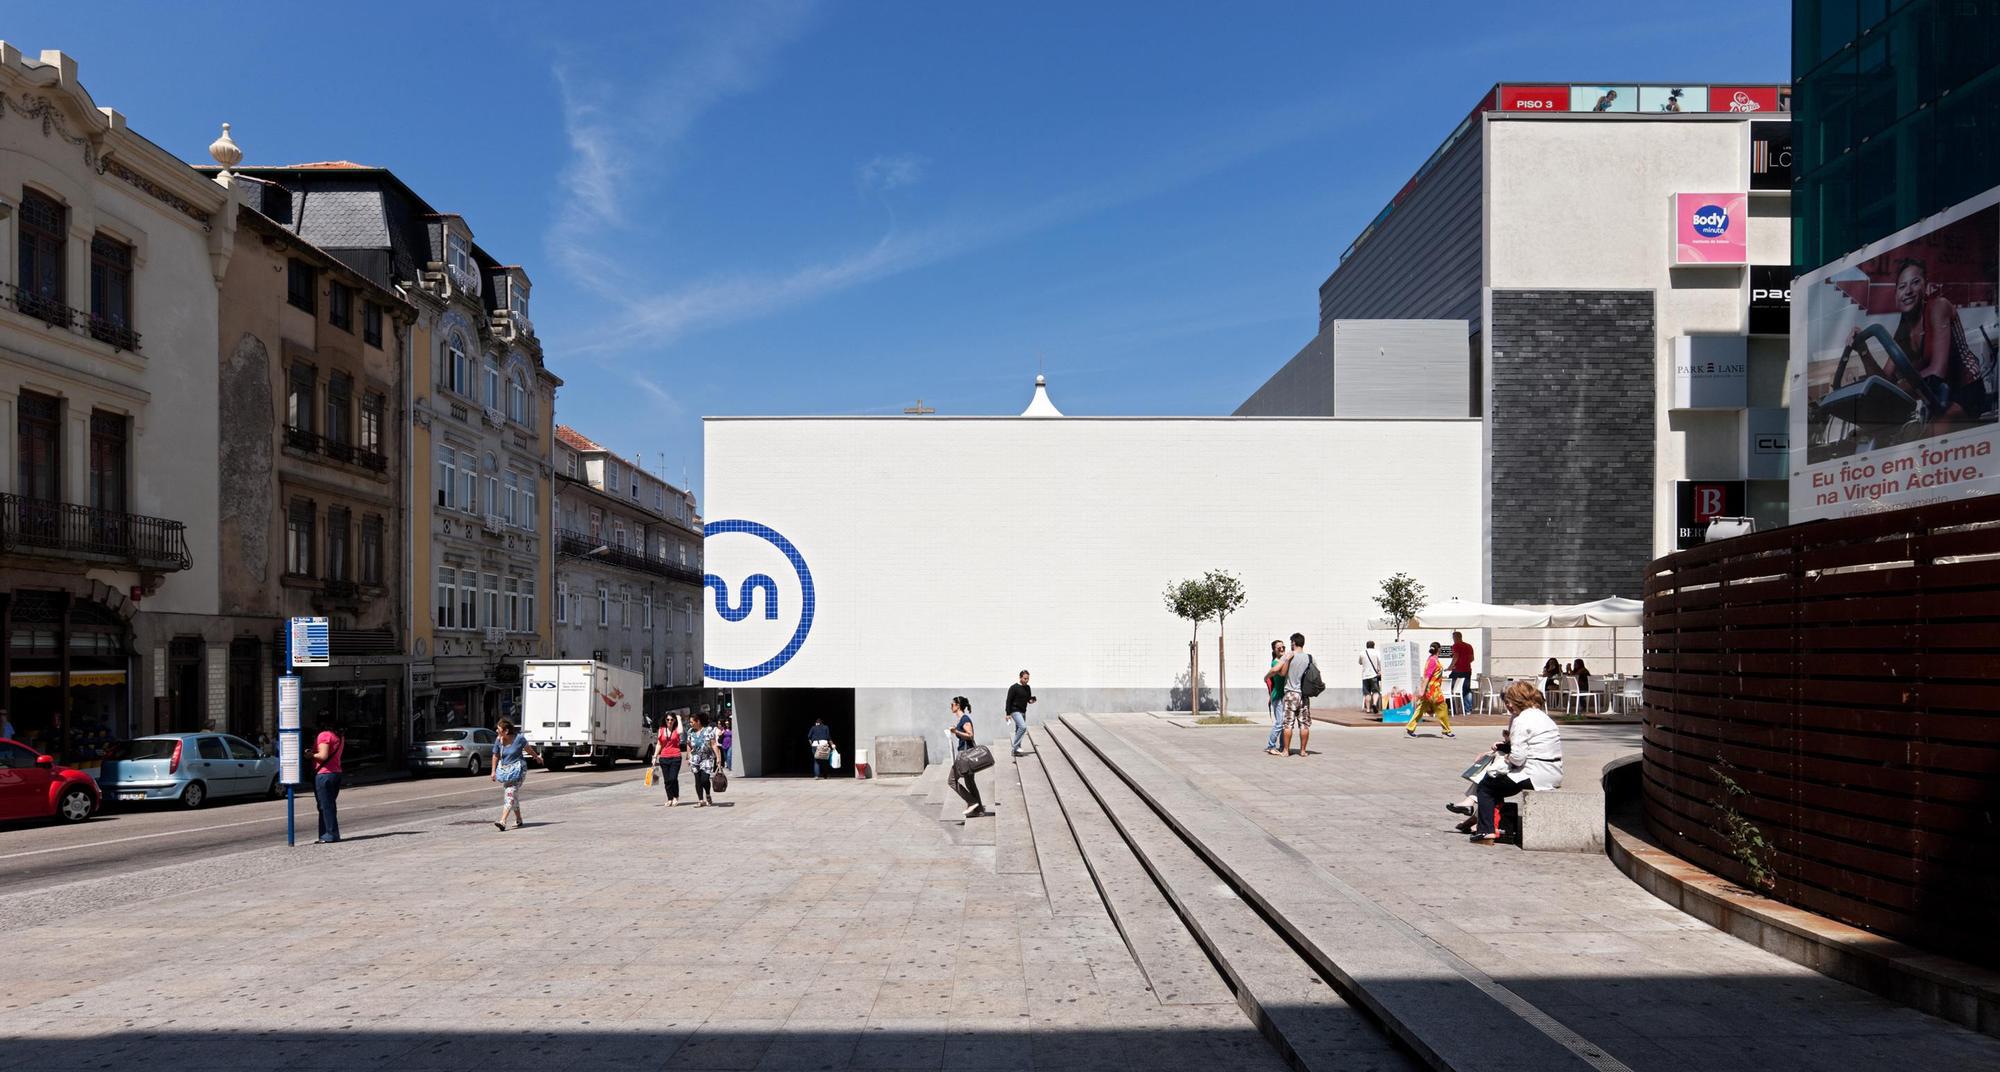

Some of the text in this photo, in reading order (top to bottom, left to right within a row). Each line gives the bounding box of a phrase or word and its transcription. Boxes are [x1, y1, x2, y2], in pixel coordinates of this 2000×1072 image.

[1516, 100, 1553, 109] PISO 3
[1702, 226, 1725, 234] minute
[1677, 364, 1745, 374] PARK LANE
[1758, 439, 1790, 449] CL
[1812, 440, 1992, 489] Eu fico em forma
[1816, 465, 1984, 506] na Virgin Active.
[1700, 488, 1722, 515] B
